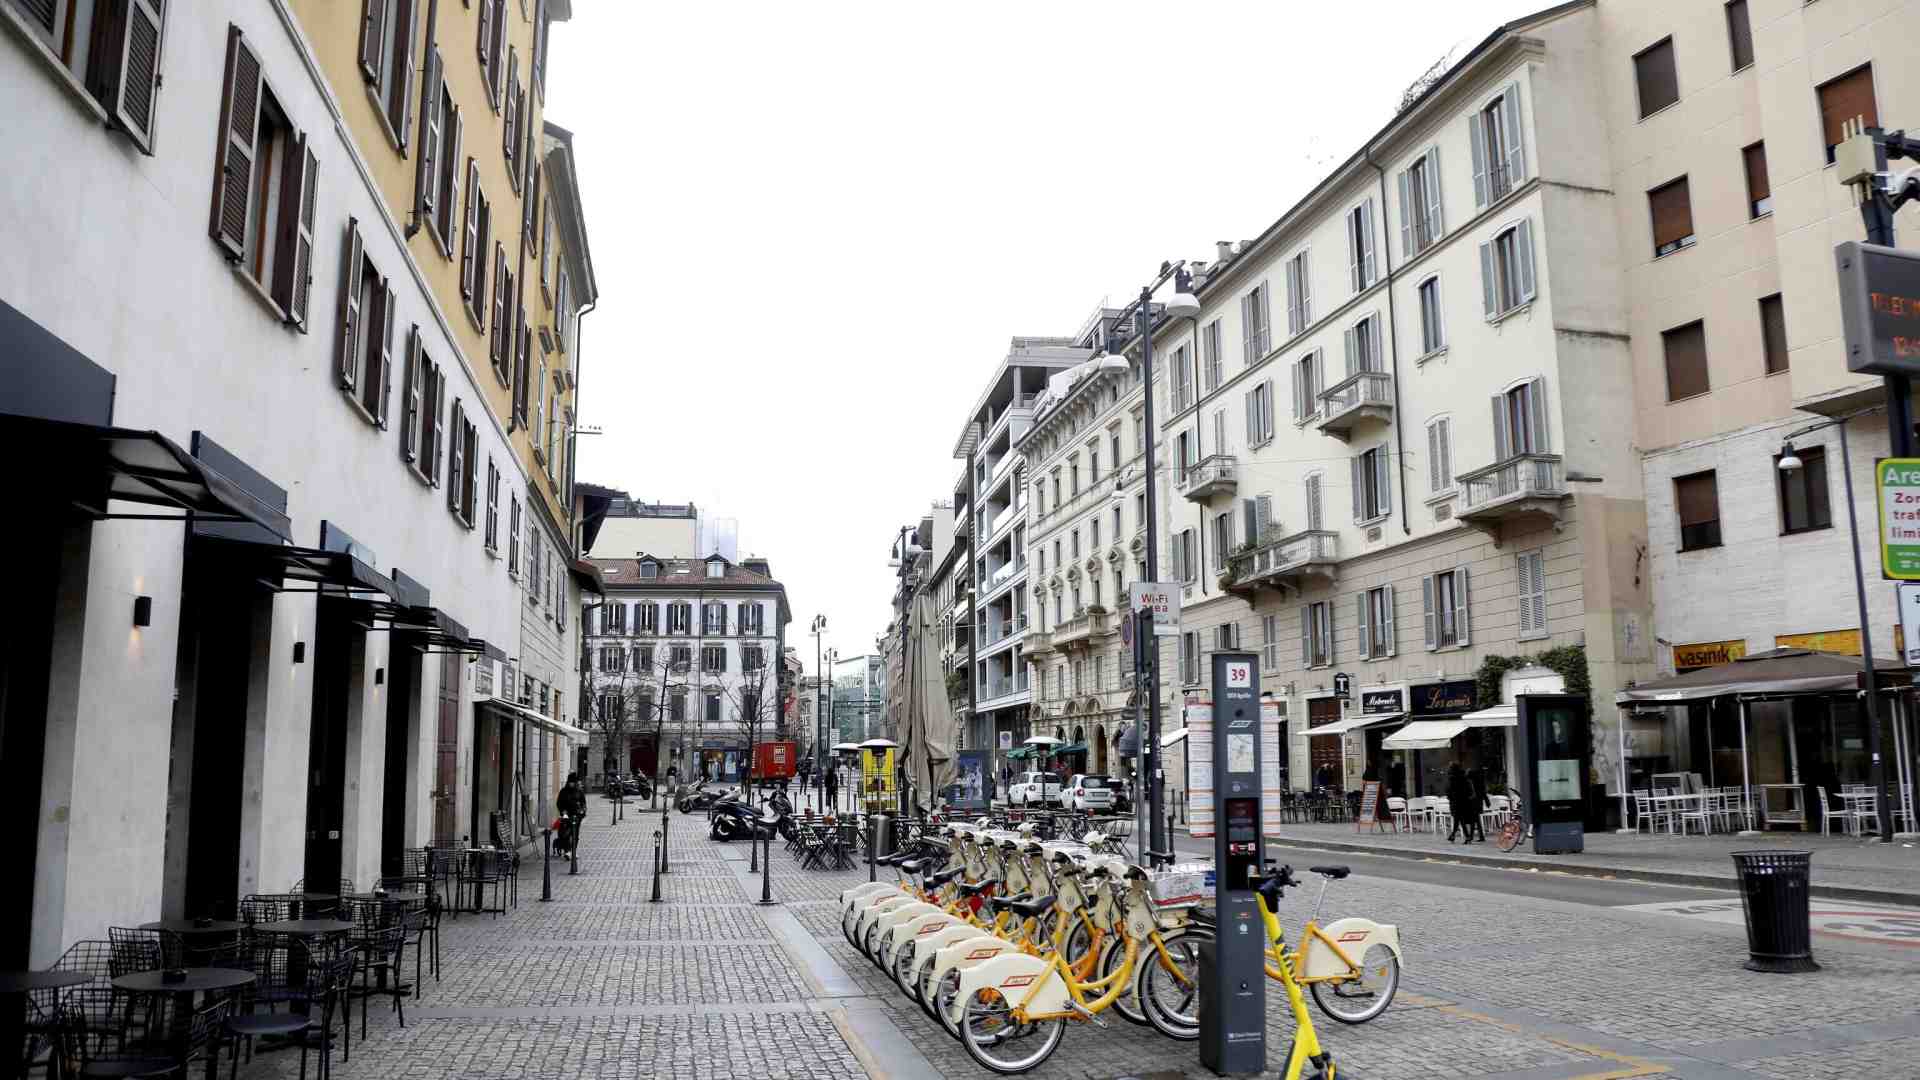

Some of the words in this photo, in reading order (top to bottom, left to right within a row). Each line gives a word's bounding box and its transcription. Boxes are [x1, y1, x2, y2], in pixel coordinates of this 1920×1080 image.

[1141, 592, 1169, 604] Wi-Fi
[1231, 668, 1246, 681] 39
[1335, 677, 1347, 692] T
